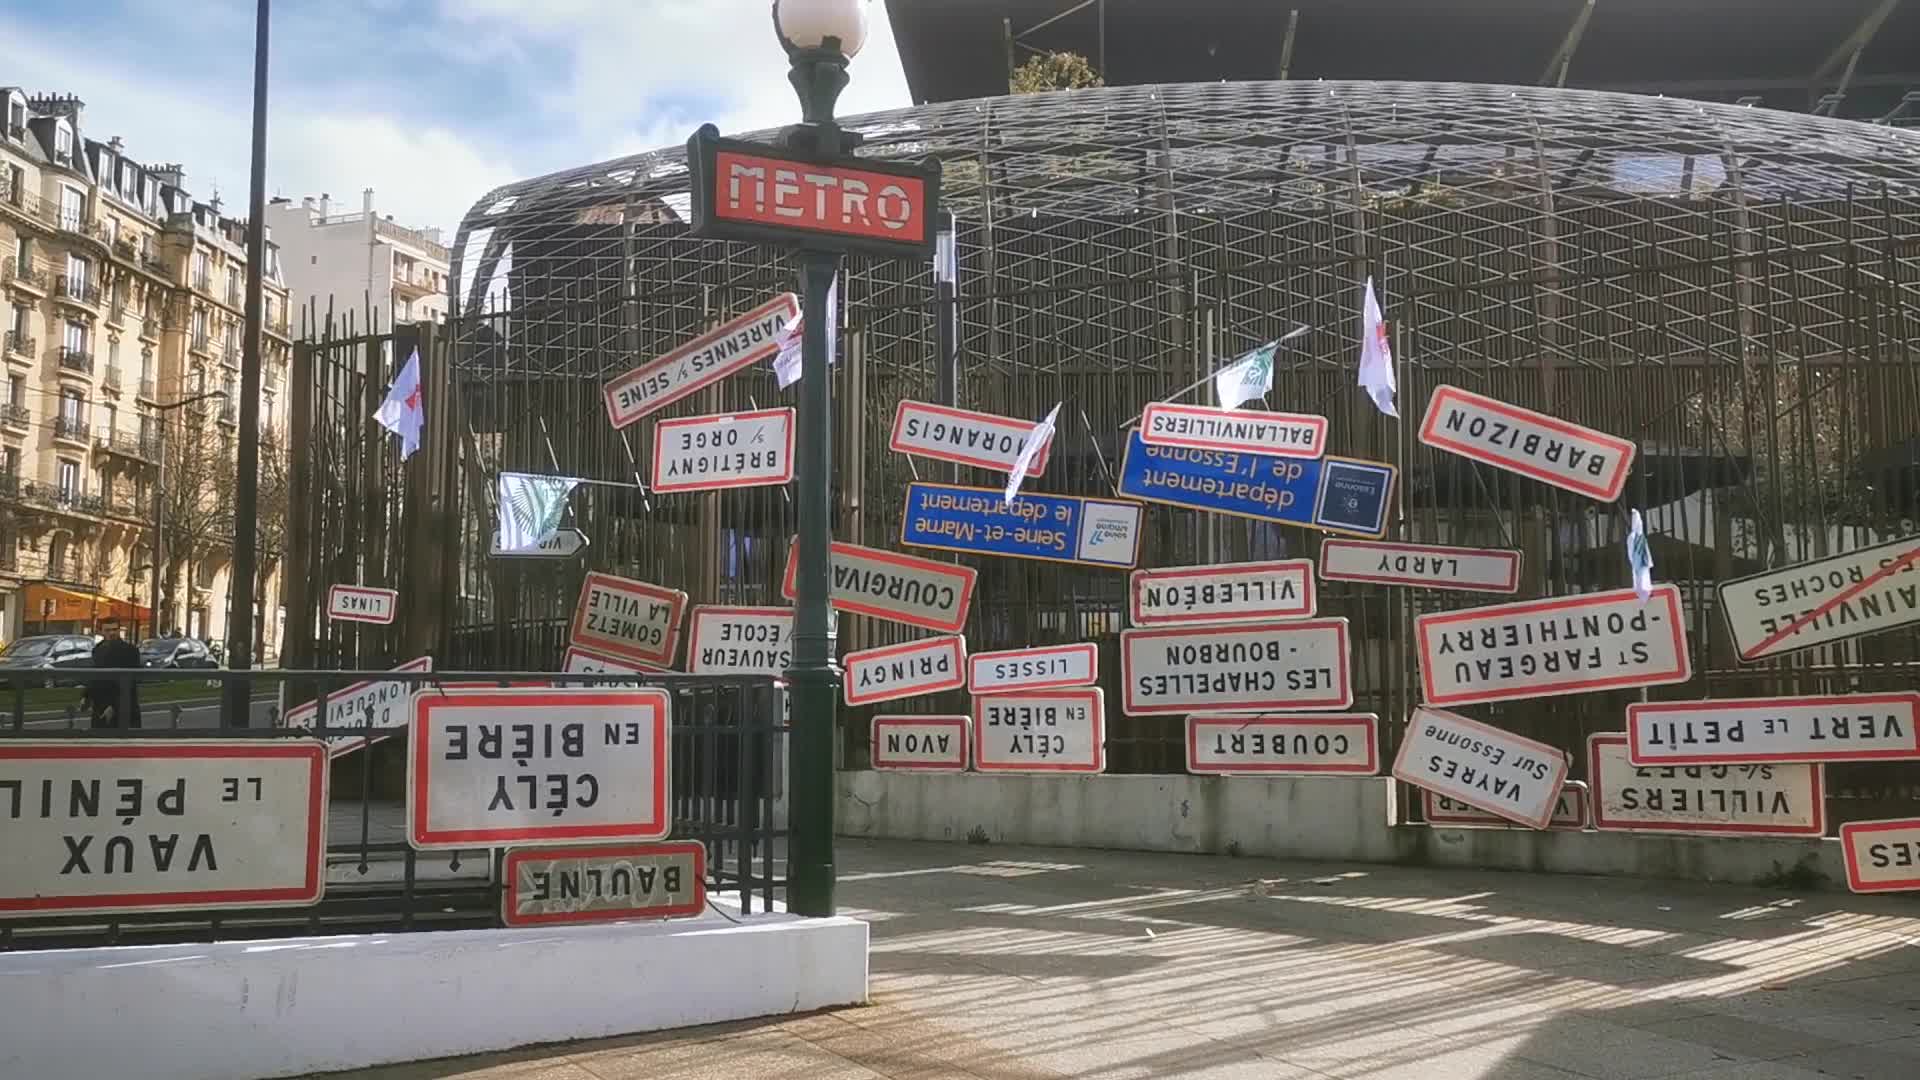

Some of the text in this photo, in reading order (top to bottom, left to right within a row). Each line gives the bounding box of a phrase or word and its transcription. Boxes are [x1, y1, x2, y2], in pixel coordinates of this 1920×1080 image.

[729, 163, 911, 230] METRO
[691, 314, 785, 372] VARENNES
[618, 372, 670, 409] SEINE
[681, 428, 738, 450] ORGE
[1152, 416, 1314, 446] BALLAINVILLIERS
[1446, 410, 1606, 477] BARBIZON
[667, 450, 777, 477] BRÉTIGNY
[1145, 446, 1258, 479] l'Essonne
[1272, 459, 1303, 484] de
[1142, 468, 1295, 512] département
[920, 492, 1072, 526] le département
[914, 517, 1067, 551] Seine-et-Marne
[1377, 554, 1458, 577] LARDY
[833, 564, 954, 610] COURGIVA
[1146, 580, 1295, 611] VILLEBÉON
[1754, 565, 1864, 607] ROCHES
[341, 595, 381, 613] LINAS
[588, 590, 670, 624] LA VILLE
[586, 612, 662, 646] GOMETZ
[720, 623, 781, 647] ÉCOLE
[701, 648, 791, 669] SAUVEUR
[858, 654, 950, 688] PRINGY
[994, 658, 1068, 680] LISSES
[1454, 647, 1601, 684] FARGEAU
[1138, 667, 1332, 697] LES CHAPELLES
[987, 706, 1085, 730] EN BIÈRE
[1763, 717, 1789, 735] LE
[1809, 715, 1904, 740] VERT
[444, 722, 640, 767] EN BIÈRE
[886, 733, 950, 754] AVON
[1008, 734, 1065, 758] CÉLY
[1213, 732, 1349, 756] COUBERT
[1424, 724, 1549, 781] Sur Essonne
[221, 777, 263, 802] LE
[487, 773, 599, 817] CÉLY
[1427, 755, 1520, 802] VAYRES
[1620, 787, 1791, 815] VILLIERS
[59, 833, 218, 875] VAUX
[531, 865, 681, 901] BAULNE
